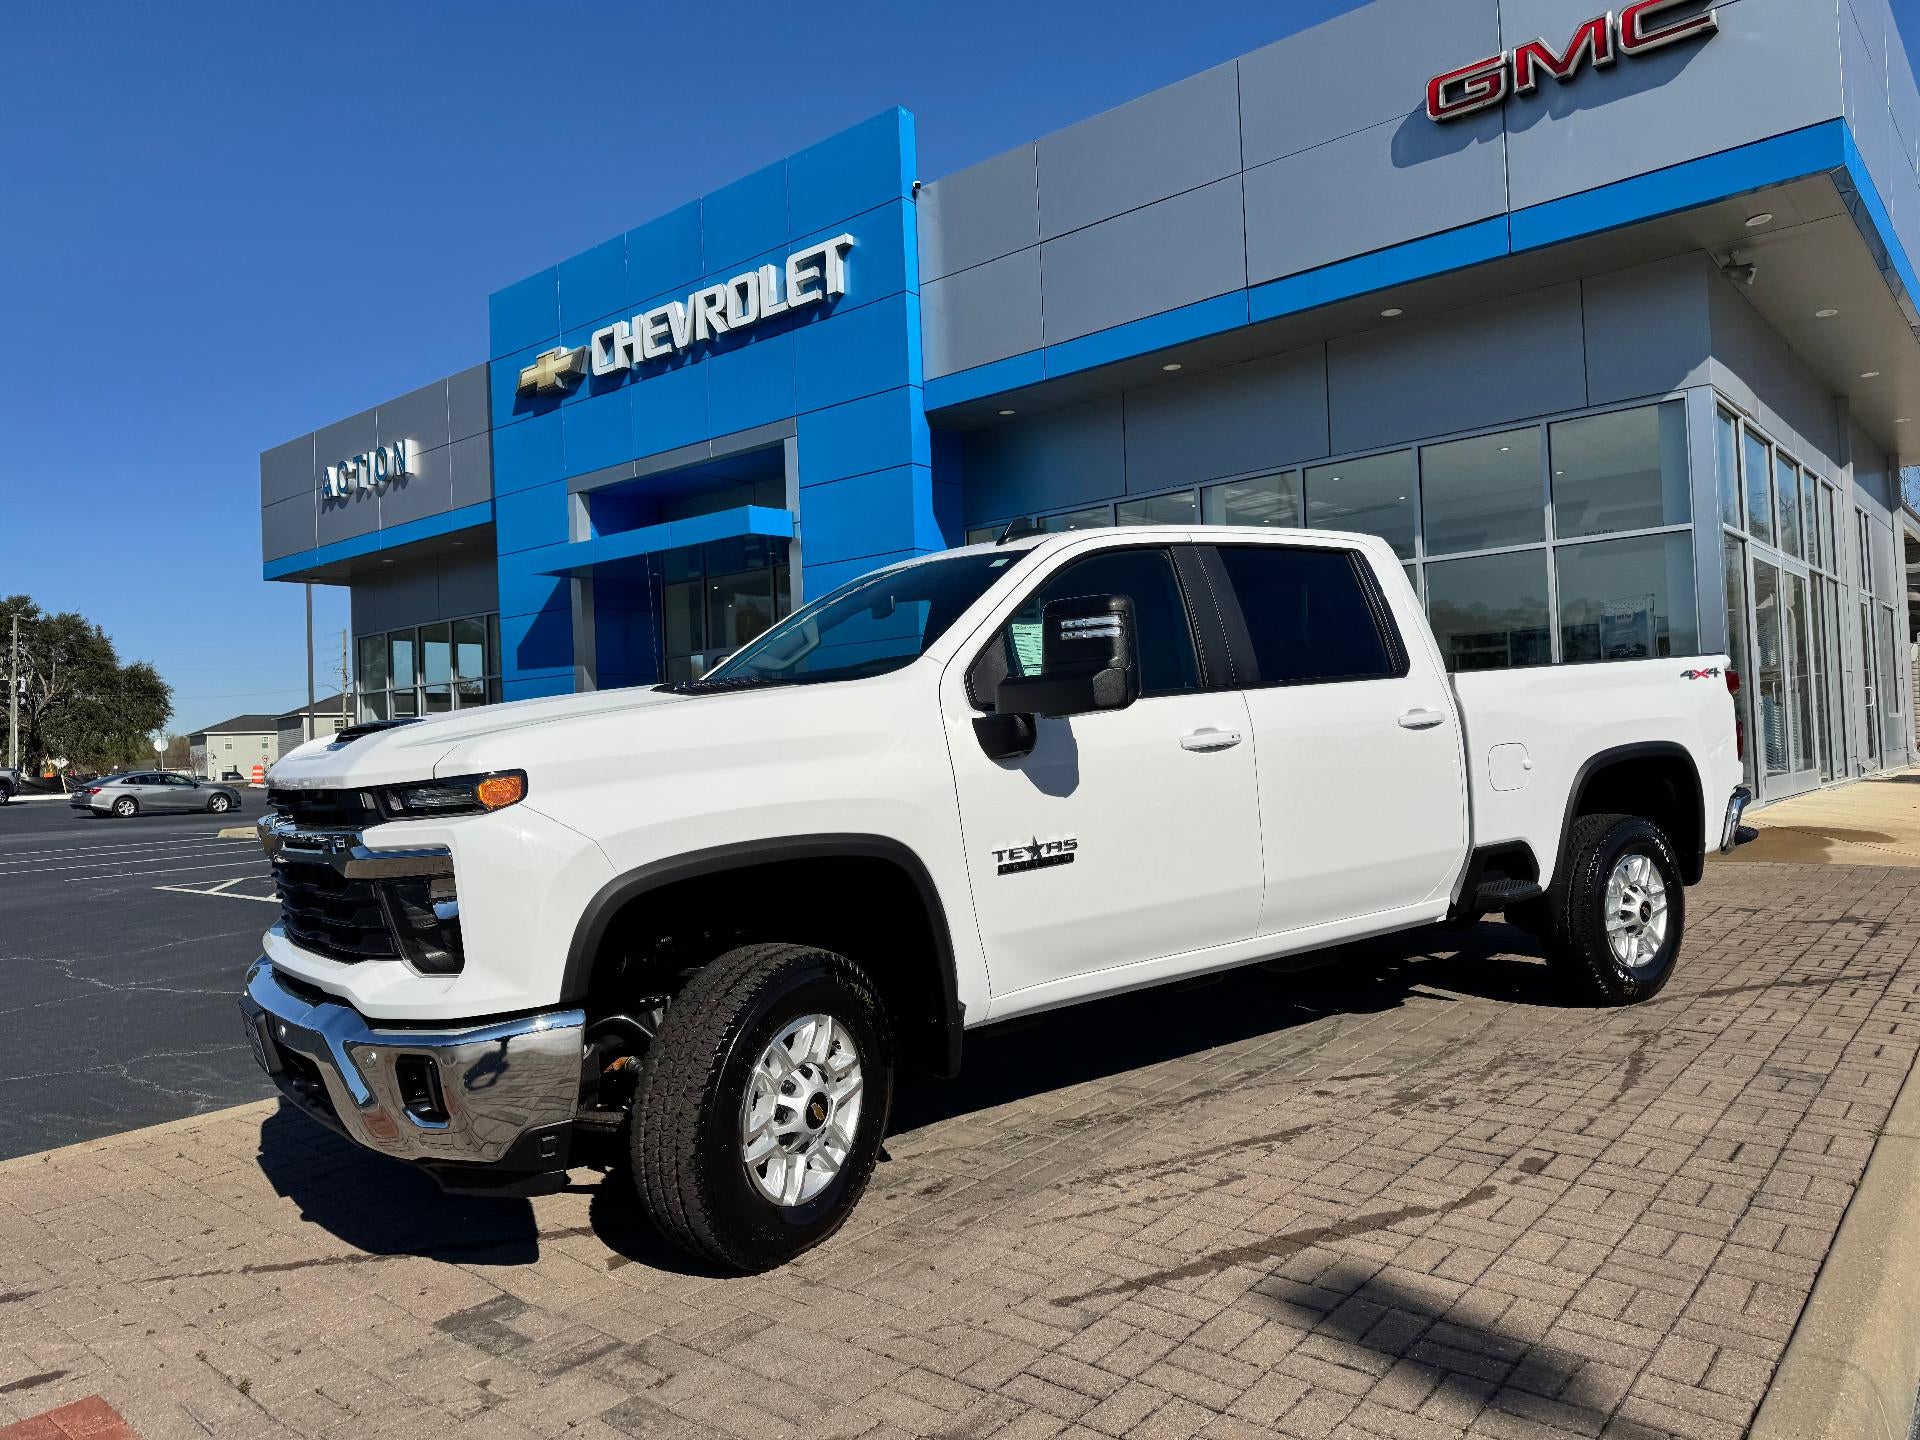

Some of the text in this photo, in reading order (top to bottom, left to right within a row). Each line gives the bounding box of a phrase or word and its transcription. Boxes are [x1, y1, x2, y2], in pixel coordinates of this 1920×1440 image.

[1425, 0, 1719, 122] GMC
[590, 232, 855, 377] CHEVROLET
[320, 438, 414, 500] ACTION
[991, 834, 1078, 862] TEXAS
